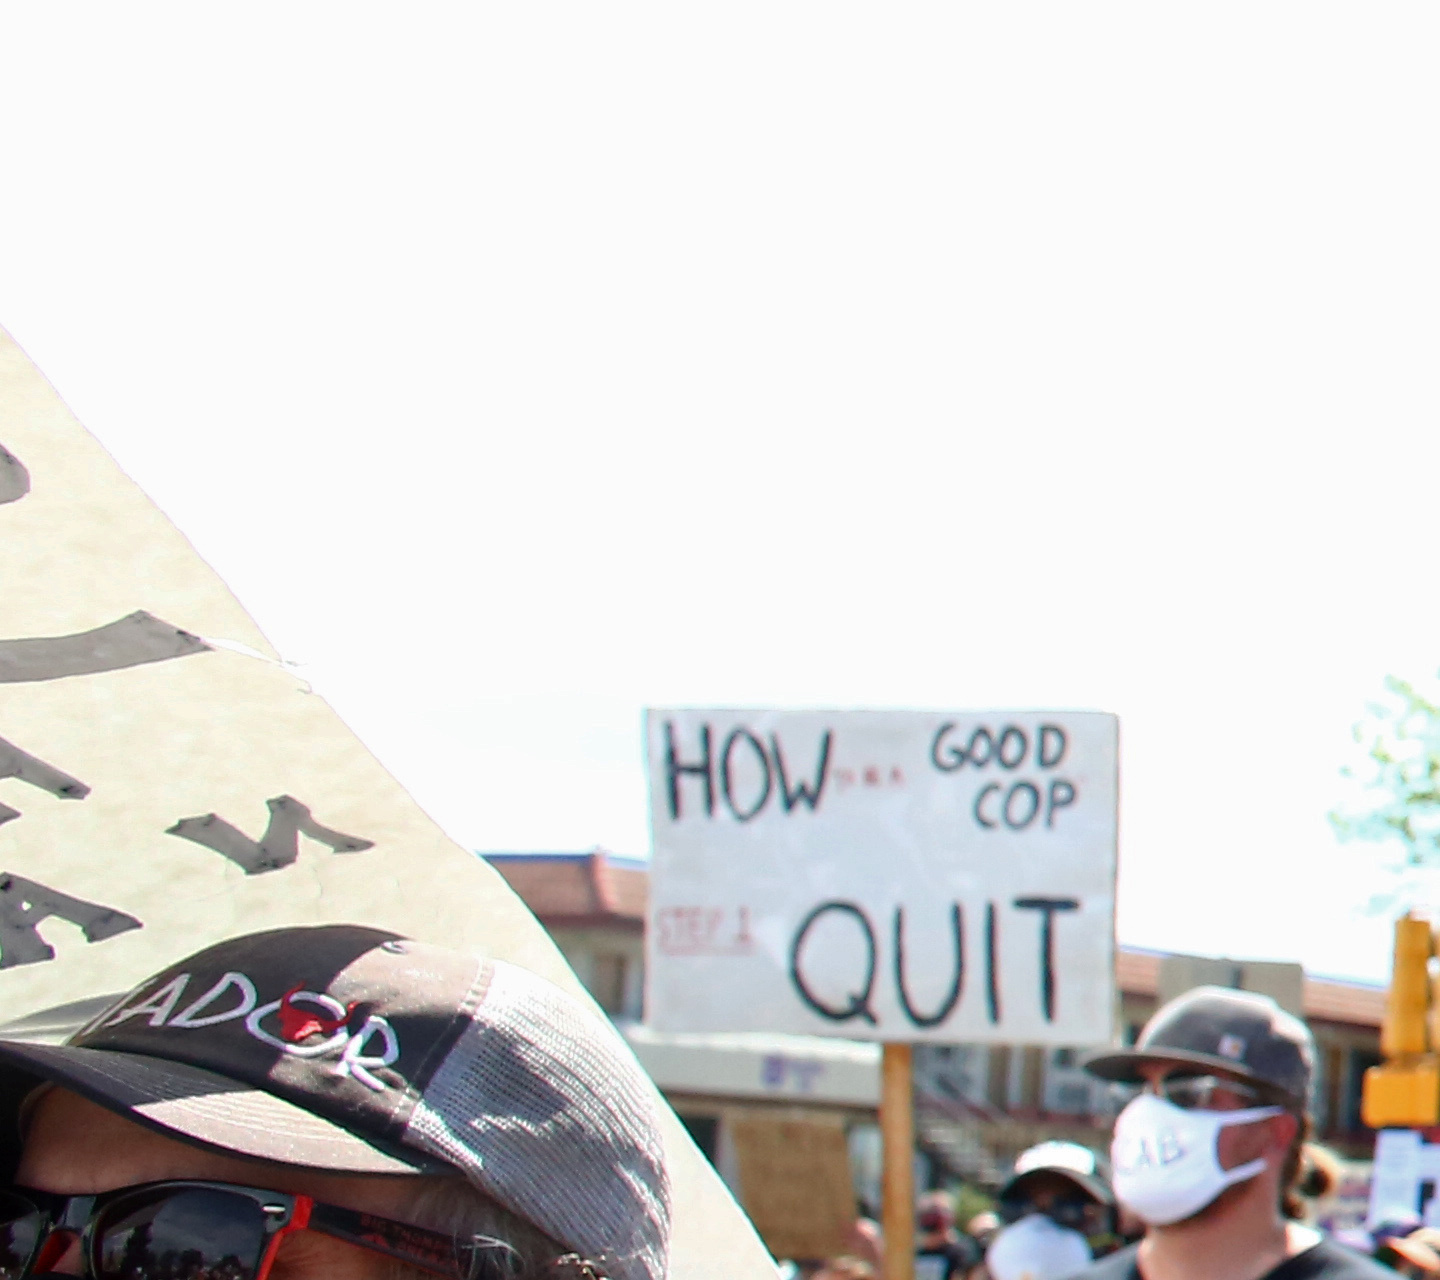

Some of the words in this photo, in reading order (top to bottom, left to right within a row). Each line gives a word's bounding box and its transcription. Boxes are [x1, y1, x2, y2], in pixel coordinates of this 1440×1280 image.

[664, 716, 836, 824] HOW
[931, 720, 1069, 773] GOOD
[973, 779, 1079, 832] COP
[788, 894, 1081, 1032] QUIT
